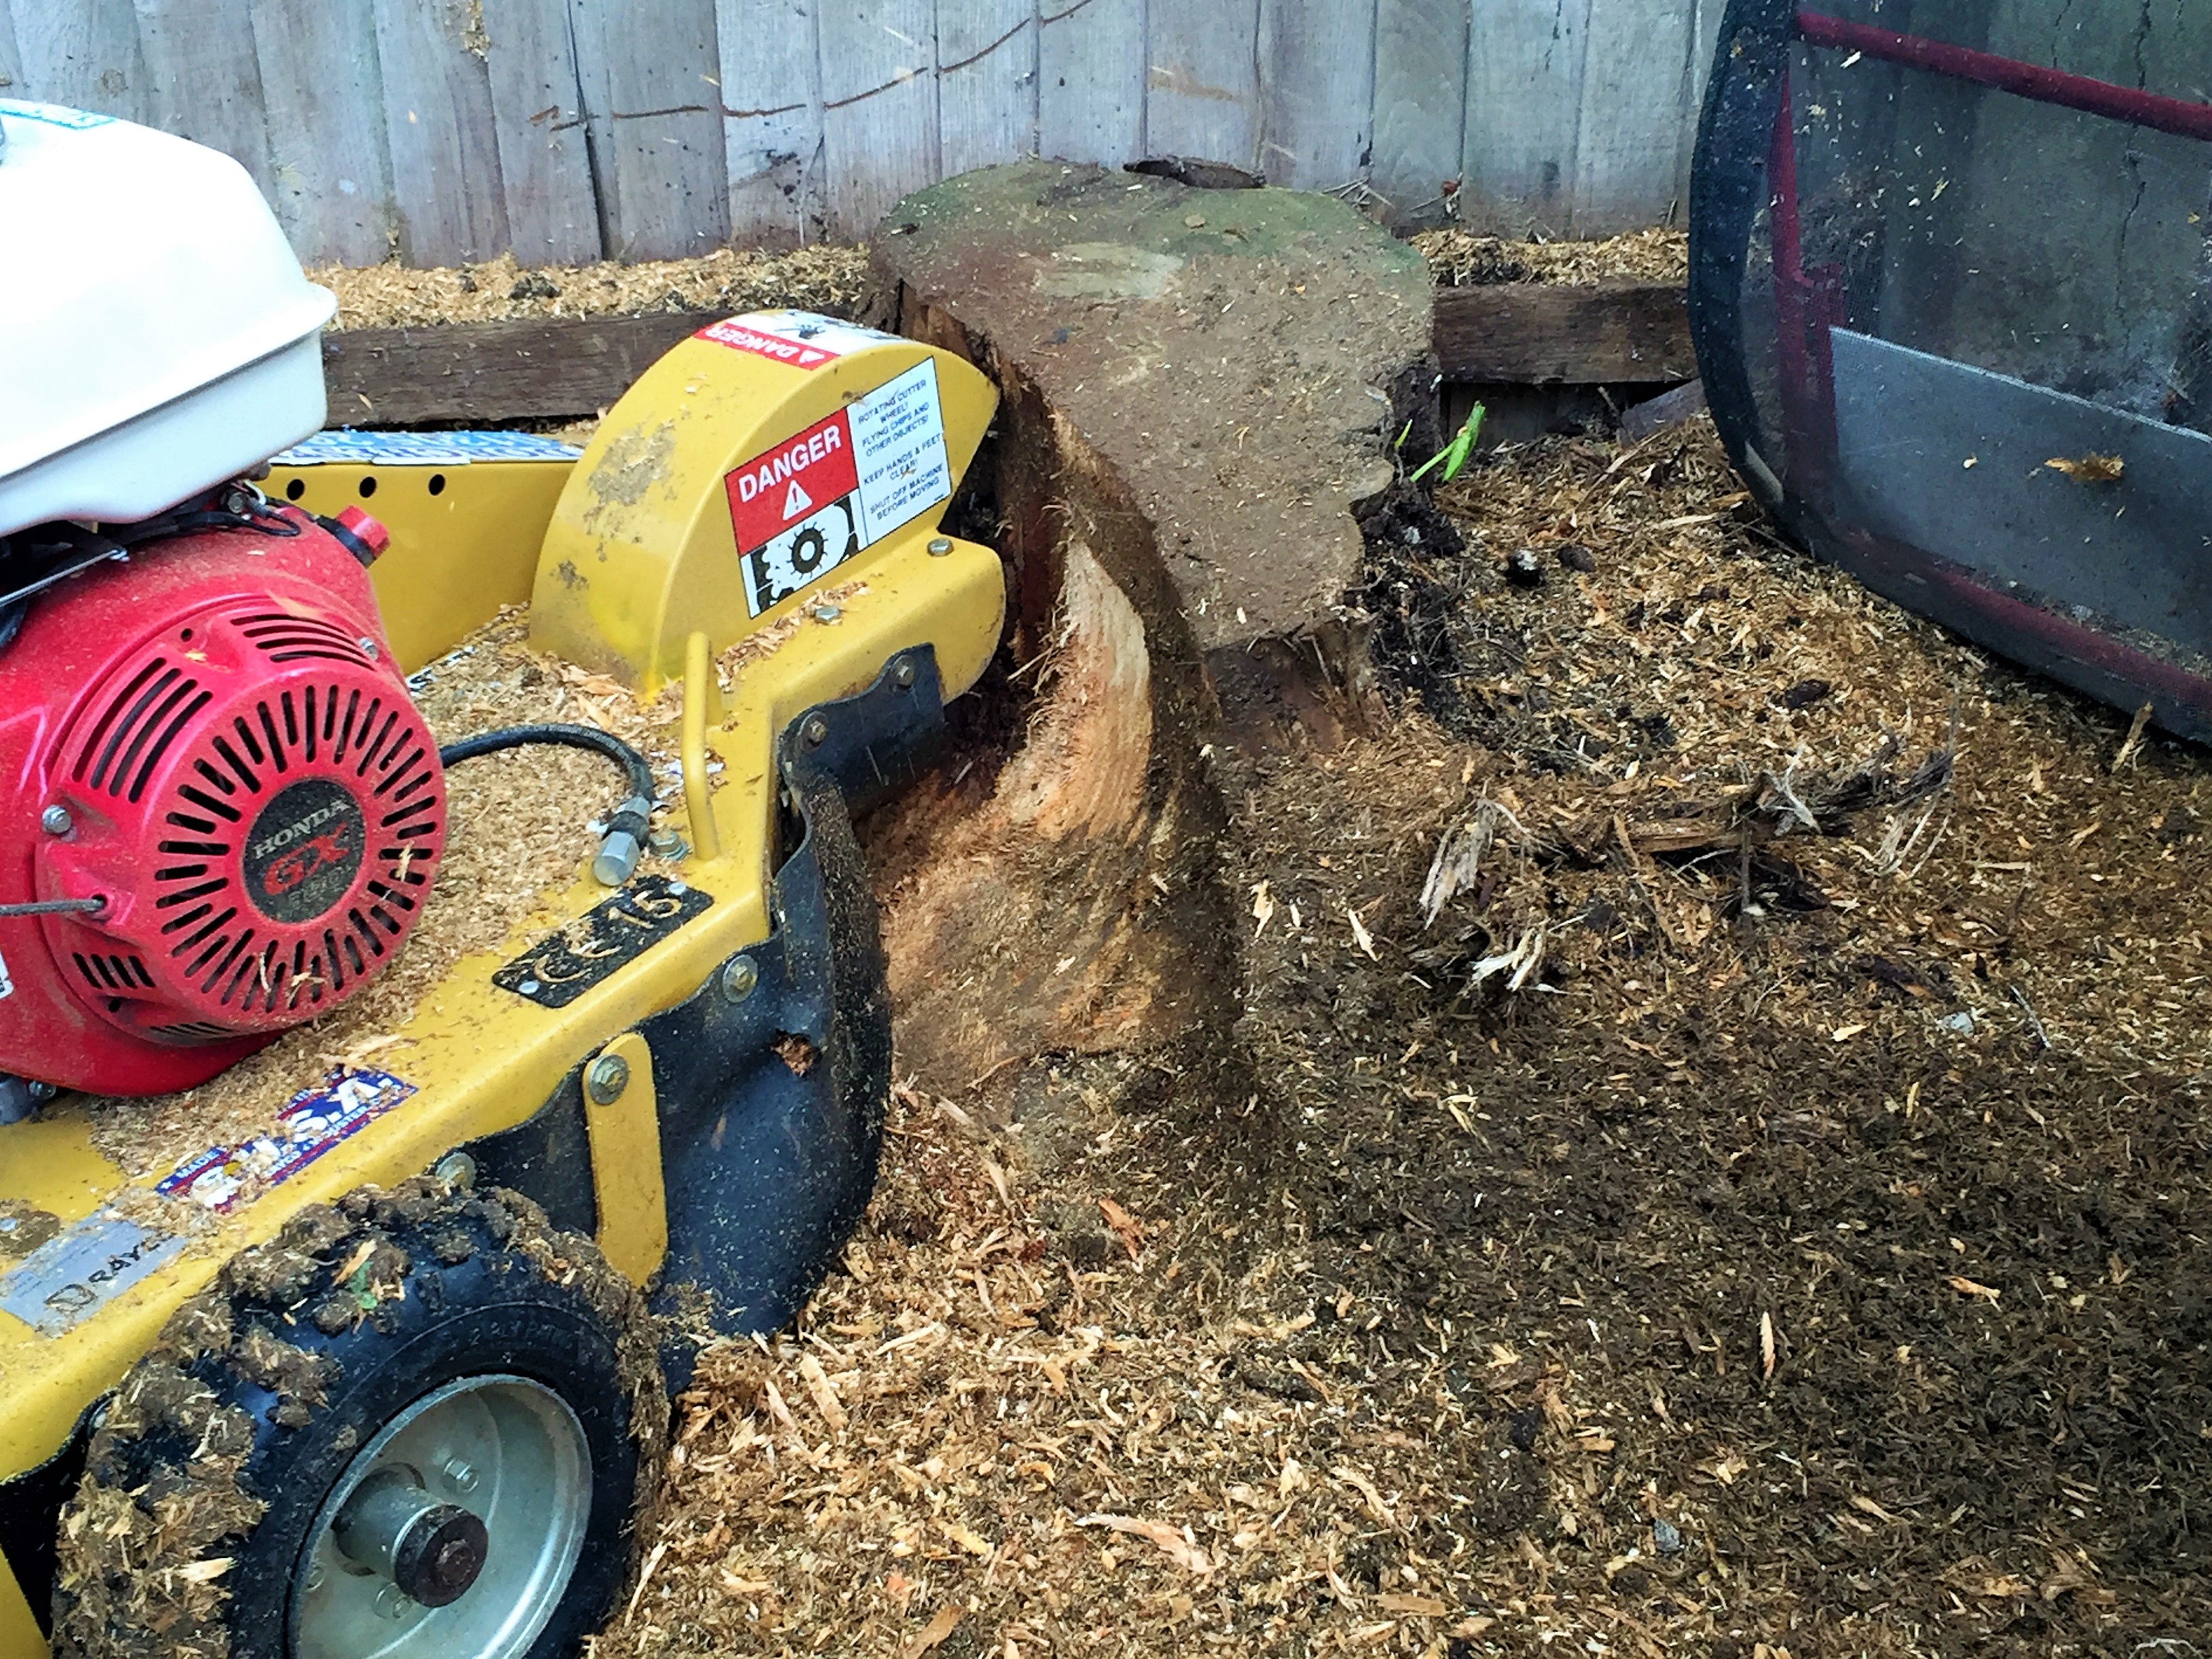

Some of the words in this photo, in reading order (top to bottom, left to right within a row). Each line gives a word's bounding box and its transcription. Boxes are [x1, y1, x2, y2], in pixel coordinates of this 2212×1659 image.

[705, 326, 800, 359] DANGER
[858, 396, 896, 425] ROTATING
[897, 380, 926, 401] CUTTER
[862, 426, 888, 447] FLYING
[890, 412, 912, 430] CHIPS
[914, 402, 929, 416] AND
[738, 425, 842, 503] DANGER
[864, 468, 884, 485] KEEP
[886, 450, 913, 472] HANDS
[922, 433, 941, 450] FEET
[866, 437, 892, 457] OTHER
[870, 496, 890, 514] SHUT
[893, 485, 907, 500] OFF
[909, 462, 943, 489] MACHINE
[877, 495, 907, 520] BEFORE
[909, 476, 939, 499] MOVING
[253, 796, 351, 859] HONDA
[263, 821, 349, 895] GX
[176, 1150, 220, 1179] MADE
